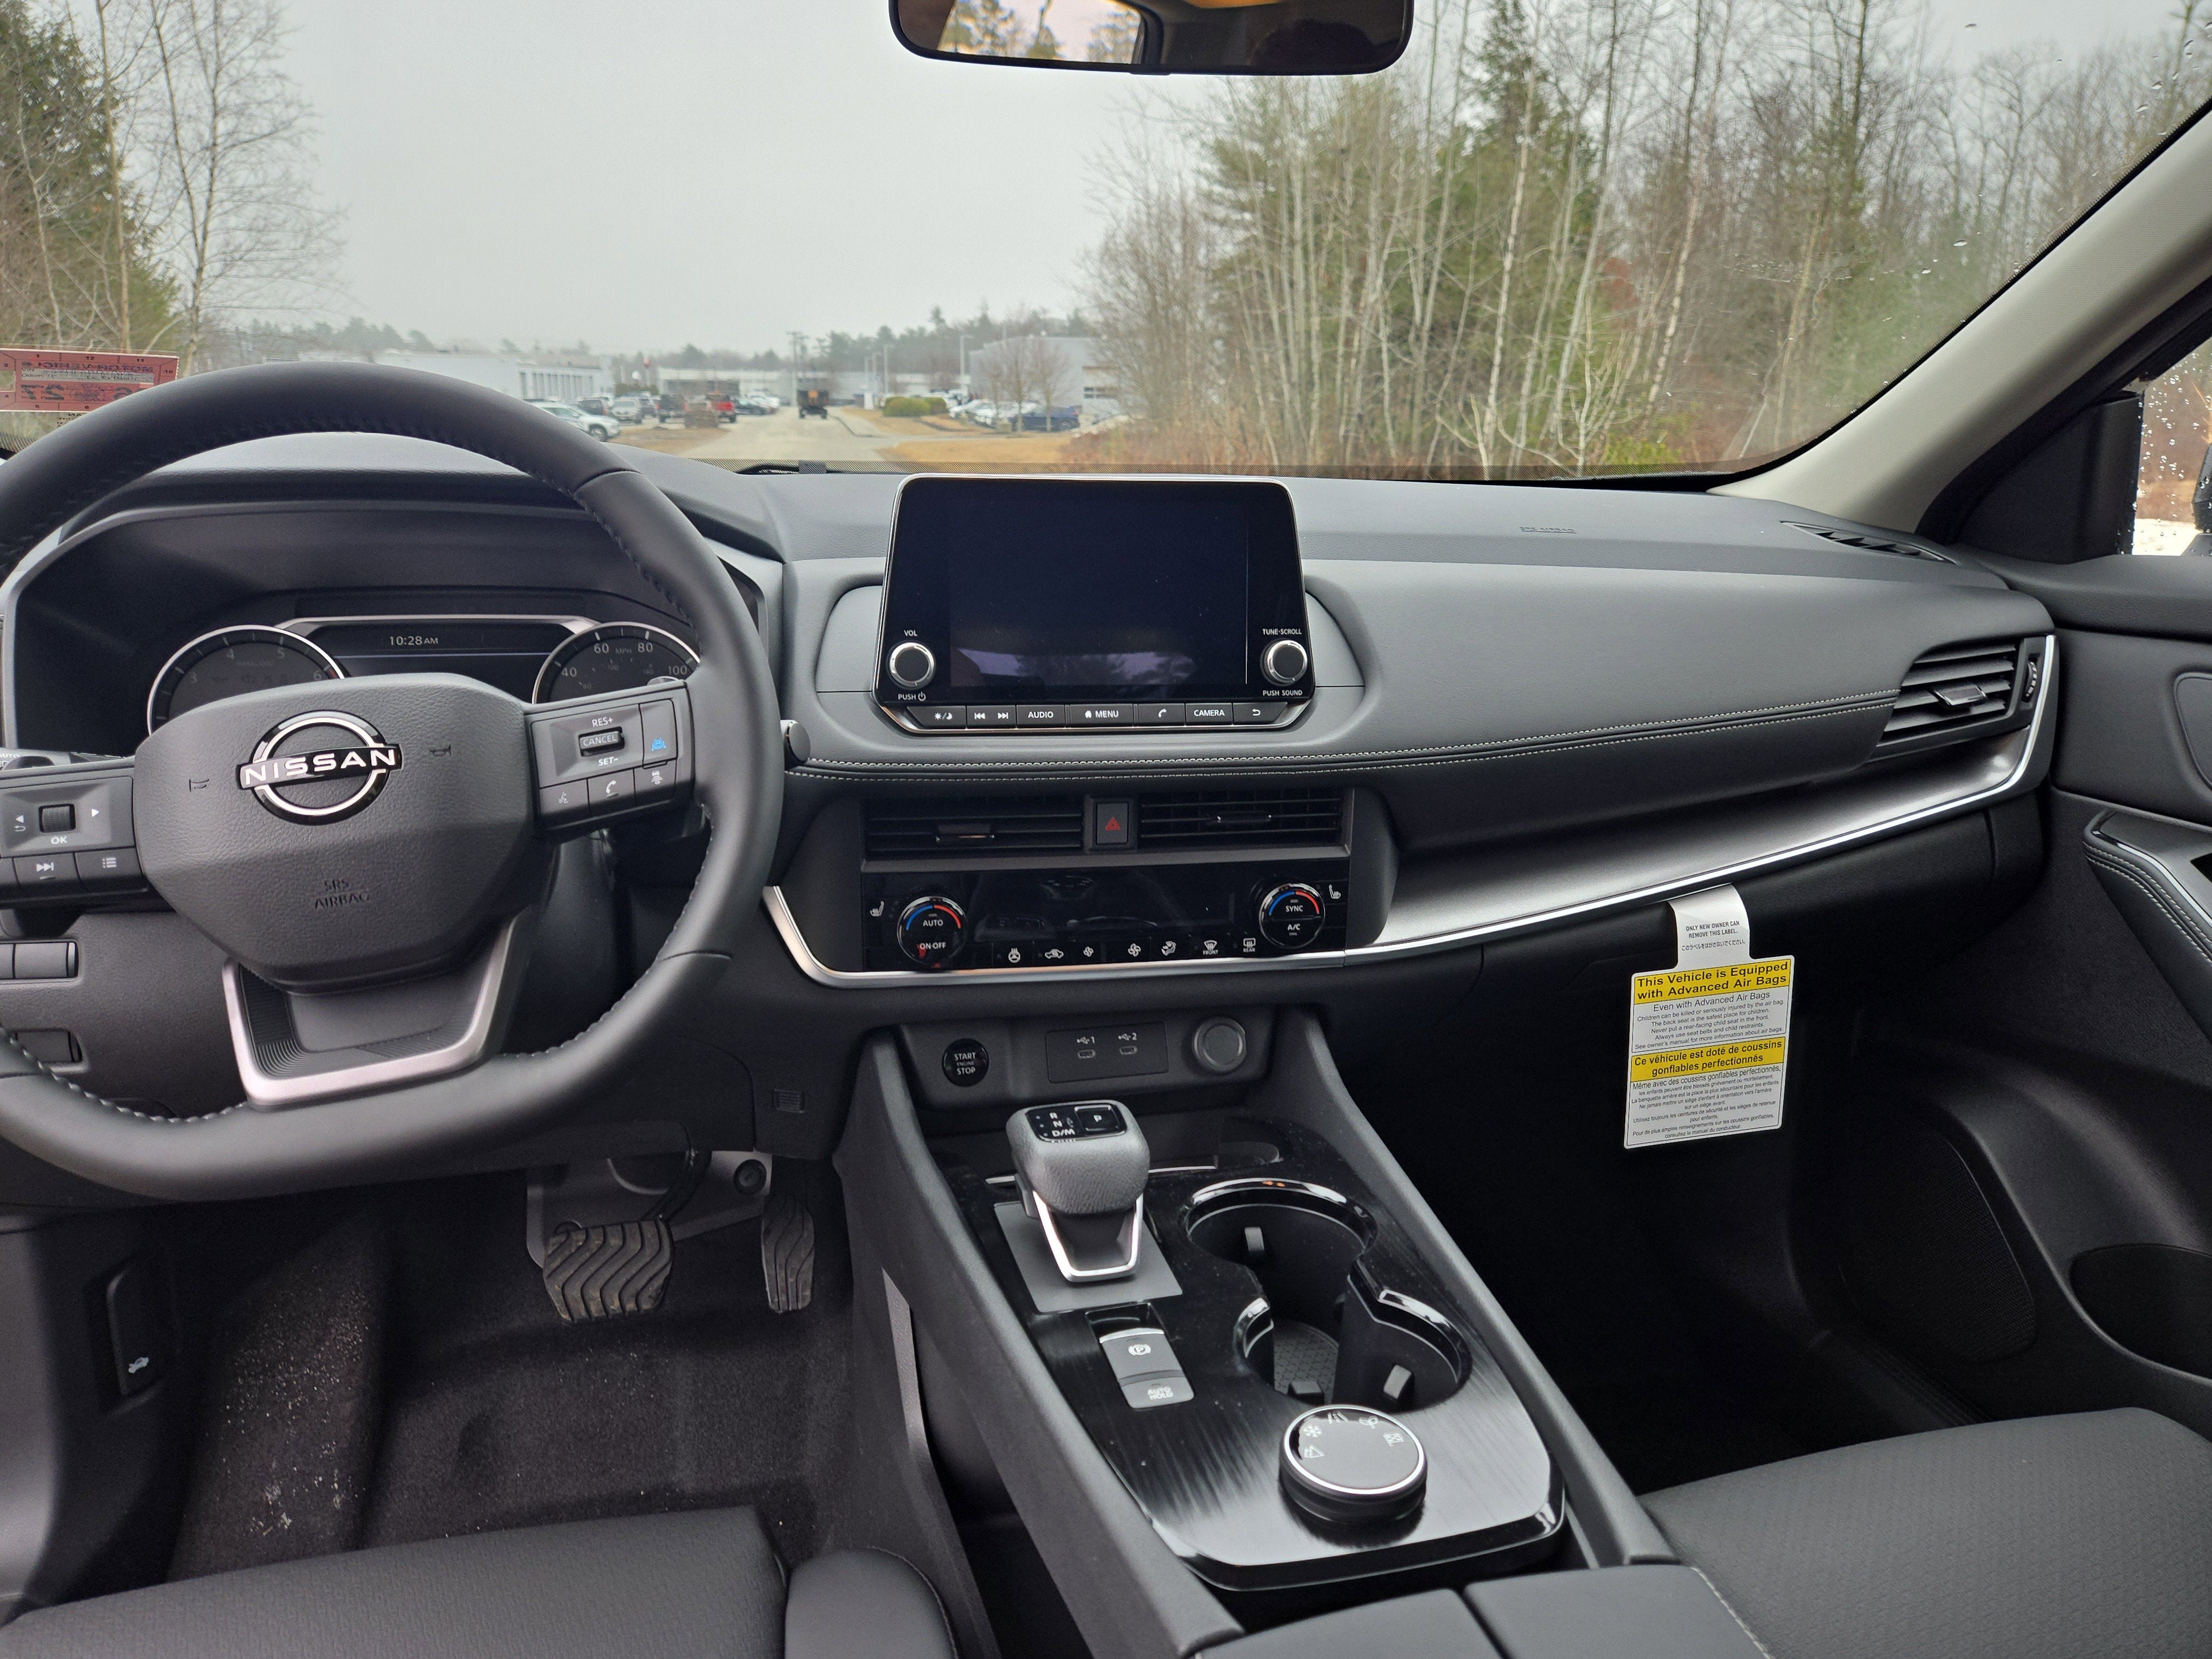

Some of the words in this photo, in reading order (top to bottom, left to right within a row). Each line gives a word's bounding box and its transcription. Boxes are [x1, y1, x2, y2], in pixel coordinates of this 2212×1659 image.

[594, 642, 609, 654] 60
[637, 642, 653, 653] 80
[226, 648, 234, 660] 4
[561, 667, 577, 678] 40
[668, 665, 687, 676] 100
[1282, 689, 1303, 697] SOUND
[1028, 711, 1054, 719] AUDIO
[1095, 710, 1119, 718] MENU
[1193, 709, 1225, 717] CAMERA
[583, 735, 618, 747] CANCEL
[245, 749, 396, 785] NISSAN
[50, 835, 68, 845] OK
[1285, 904, 1304, 912] SYNC
[1637, 977, 1663, 987] This
[1667, 971, 1712, 983] Vehicle
[1716, 969, 1726, 978] is
[1731, 961, 1787, 977] Equipped
[1637, 989, 1662, 999] with
[1668, 981, 1728, 995] Advanced
[1733, 979, 1751, 988] Air
[1756, 976, 1786, 985] Bags
[1676, 1000, 1692, 1008] with
[1694, 995, 1734, 1006] Advanced
[1736, 993, 1747, 1001] Air
[1090, 1036, 1096, 1044] 1
[1131, 1032, 1138, 1041] 2
[954, 1052, 976, 1061] START
[1635, 1057, 1646, 1065] Ce
[1649, 1052, 1687, 1064] véhicule
[1690, 1050, 1703, 1058] est
[1706, 1046, 1725, 1056] doté
[1728, 1045, 1739, 1053] de
[1742, 1040, 1782, 1052] coussins
[1652, 1063, 1699, 1077] gonflables
[1702, 1054, 1763, 1071] perfectionnés
[957, 1066, 976, 1076] STOP
[1681, 1075, 1706, 1083] coussins
[1708, 1071, 1738, 1082] gonflables
[1094, 1114, 1103, 1123] P
[1053, 1120, 1063, 1128] N
[1052, 1128, 1076, 1137] D/M
